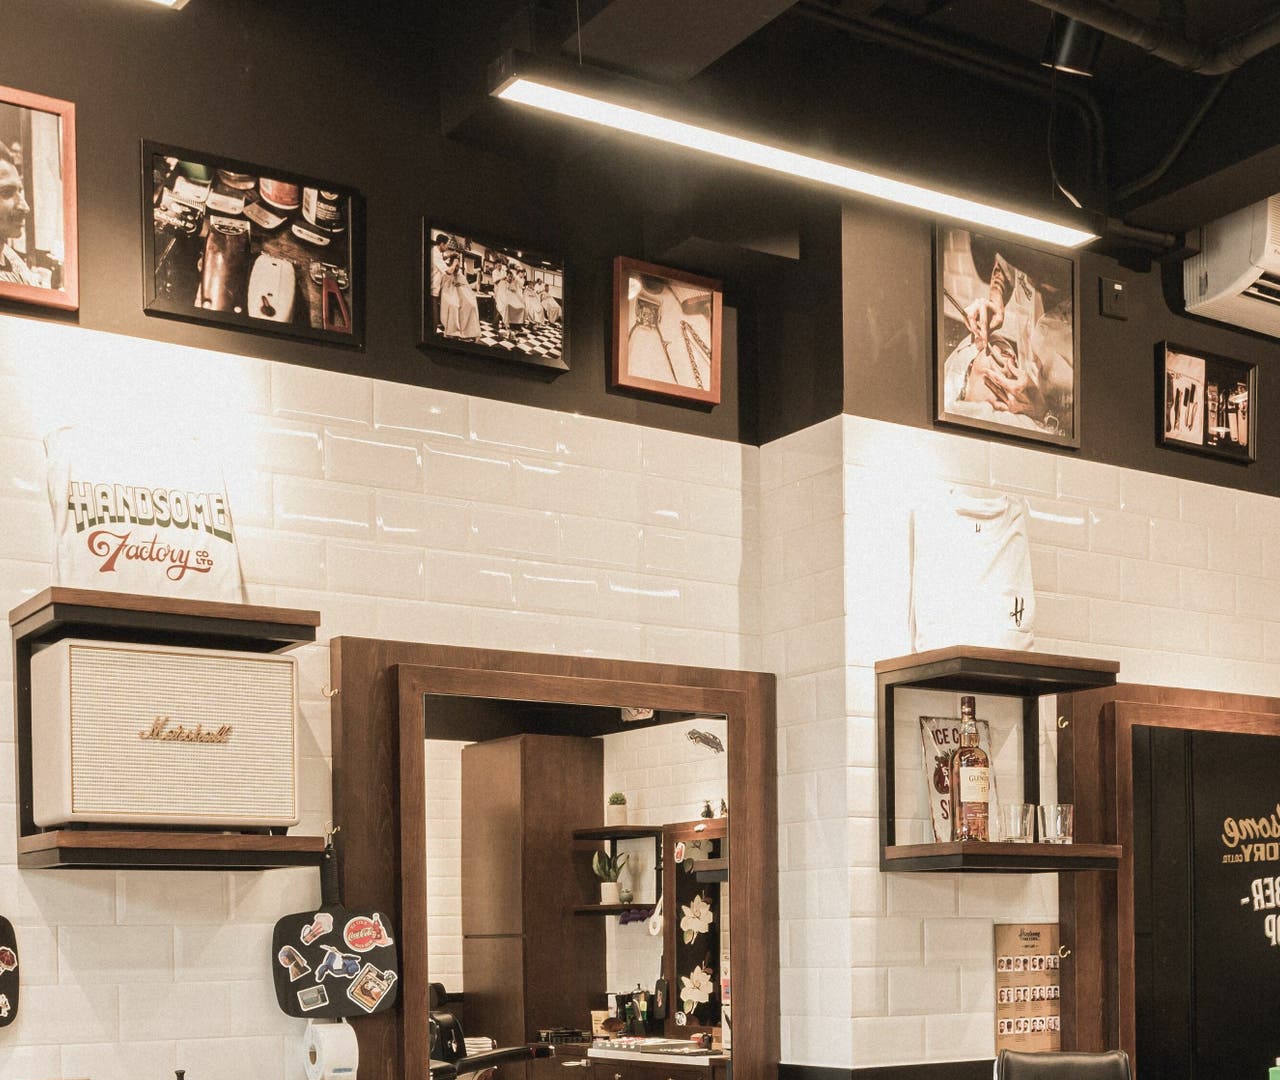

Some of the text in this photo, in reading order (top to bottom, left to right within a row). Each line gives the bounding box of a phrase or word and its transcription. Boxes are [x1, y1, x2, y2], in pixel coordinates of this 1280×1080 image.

[68, 480, 234, 544] HANDSOME
[87, 530, 211, 581] Factory
[138, 715, 232, 744] Marshall
[931, 728, 950, 746] ICE
